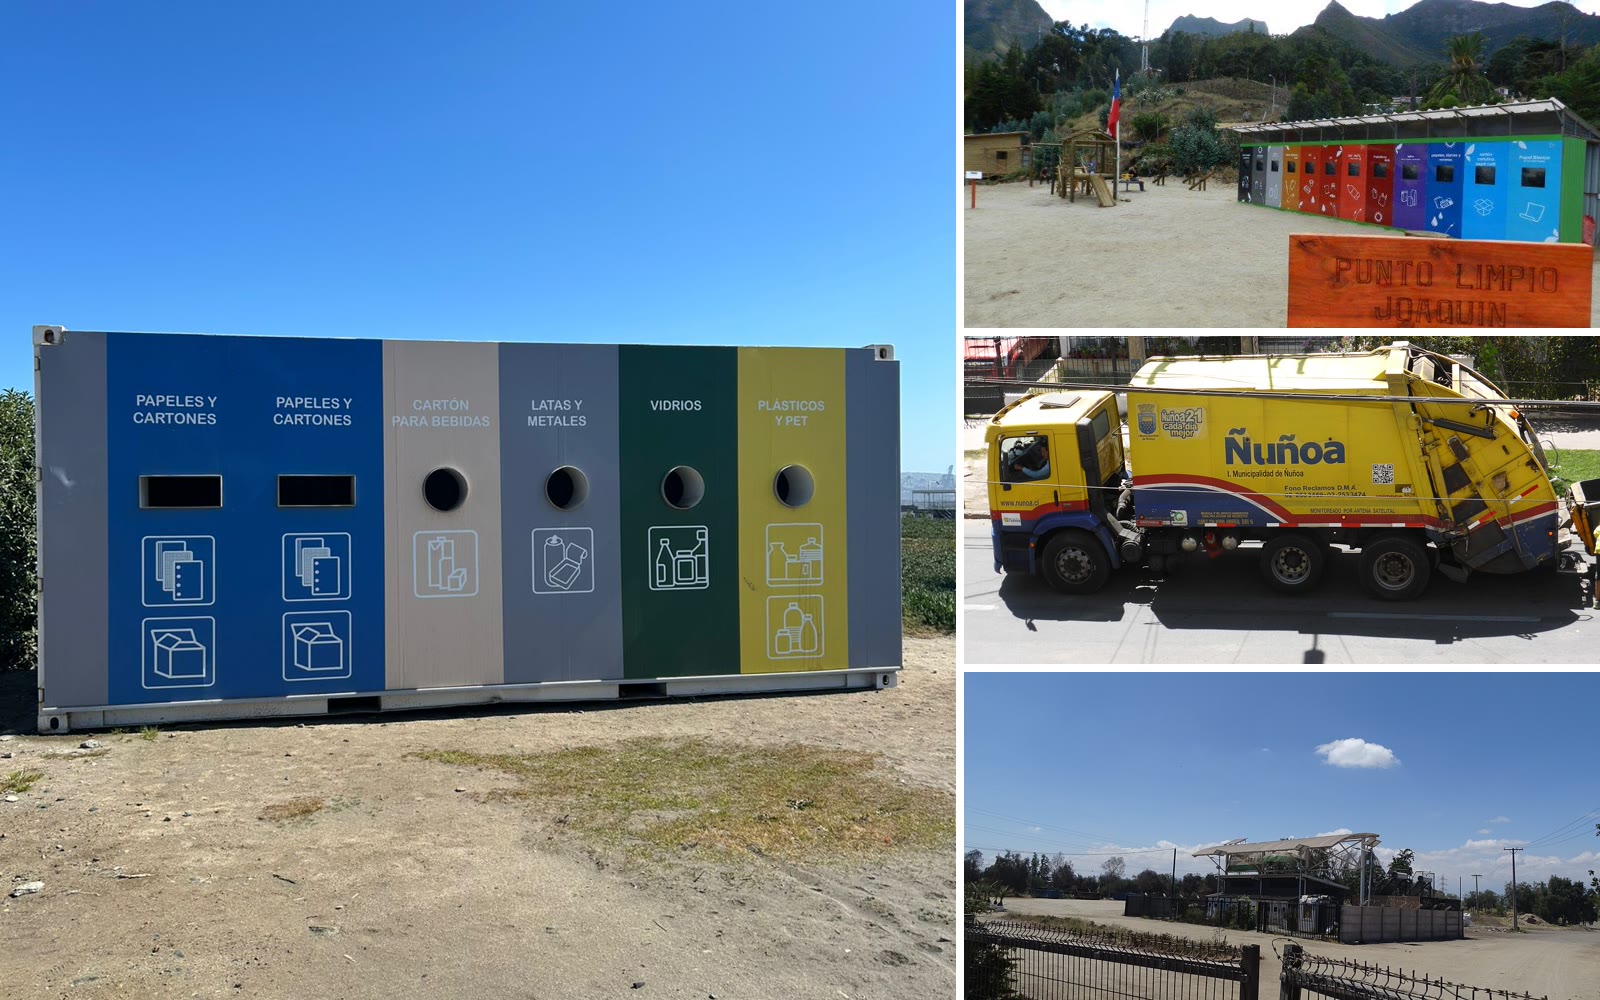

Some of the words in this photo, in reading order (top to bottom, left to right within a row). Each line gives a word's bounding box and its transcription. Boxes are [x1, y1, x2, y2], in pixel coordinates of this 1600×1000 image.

[1335, 257, 1433, 288] PUNTO
[1455, 263, 1559, 294] LIMPIO
[1374, 295, 1507, 327] JOAQUIN
[136, 394, 205, 408] PAPELES
[207, 396, 218, 408] Y
[276, 396, 341, 410] PAPELES
[342, 397, 353, 410] Y
[412, 397, 469, 411] CARTÓN
[531, 399, 572, 411] LATAS
[573, 399, 583, 411] Y
[650, 399, 702, 411] VIDRIOS
[757, 398, 825, 412] PLÁSTICOS
[132, 412, 217, 426] CARTONES
[273, 412, 352, 427] CARTONES
[391, 415, 429, 428] PARA
[431, 415, 491, 428] BEBIDAS
[527, 415, 587, 427] METALES
[775, 415, 784, 427] Y
[785, 415, 808, 427] PET
[1224, 428, 1346, 466] Ñuñoa
[1232, 470, 1273, 479] Municipalidad
[1284, 468, 1304, 477] Ñuñoa
